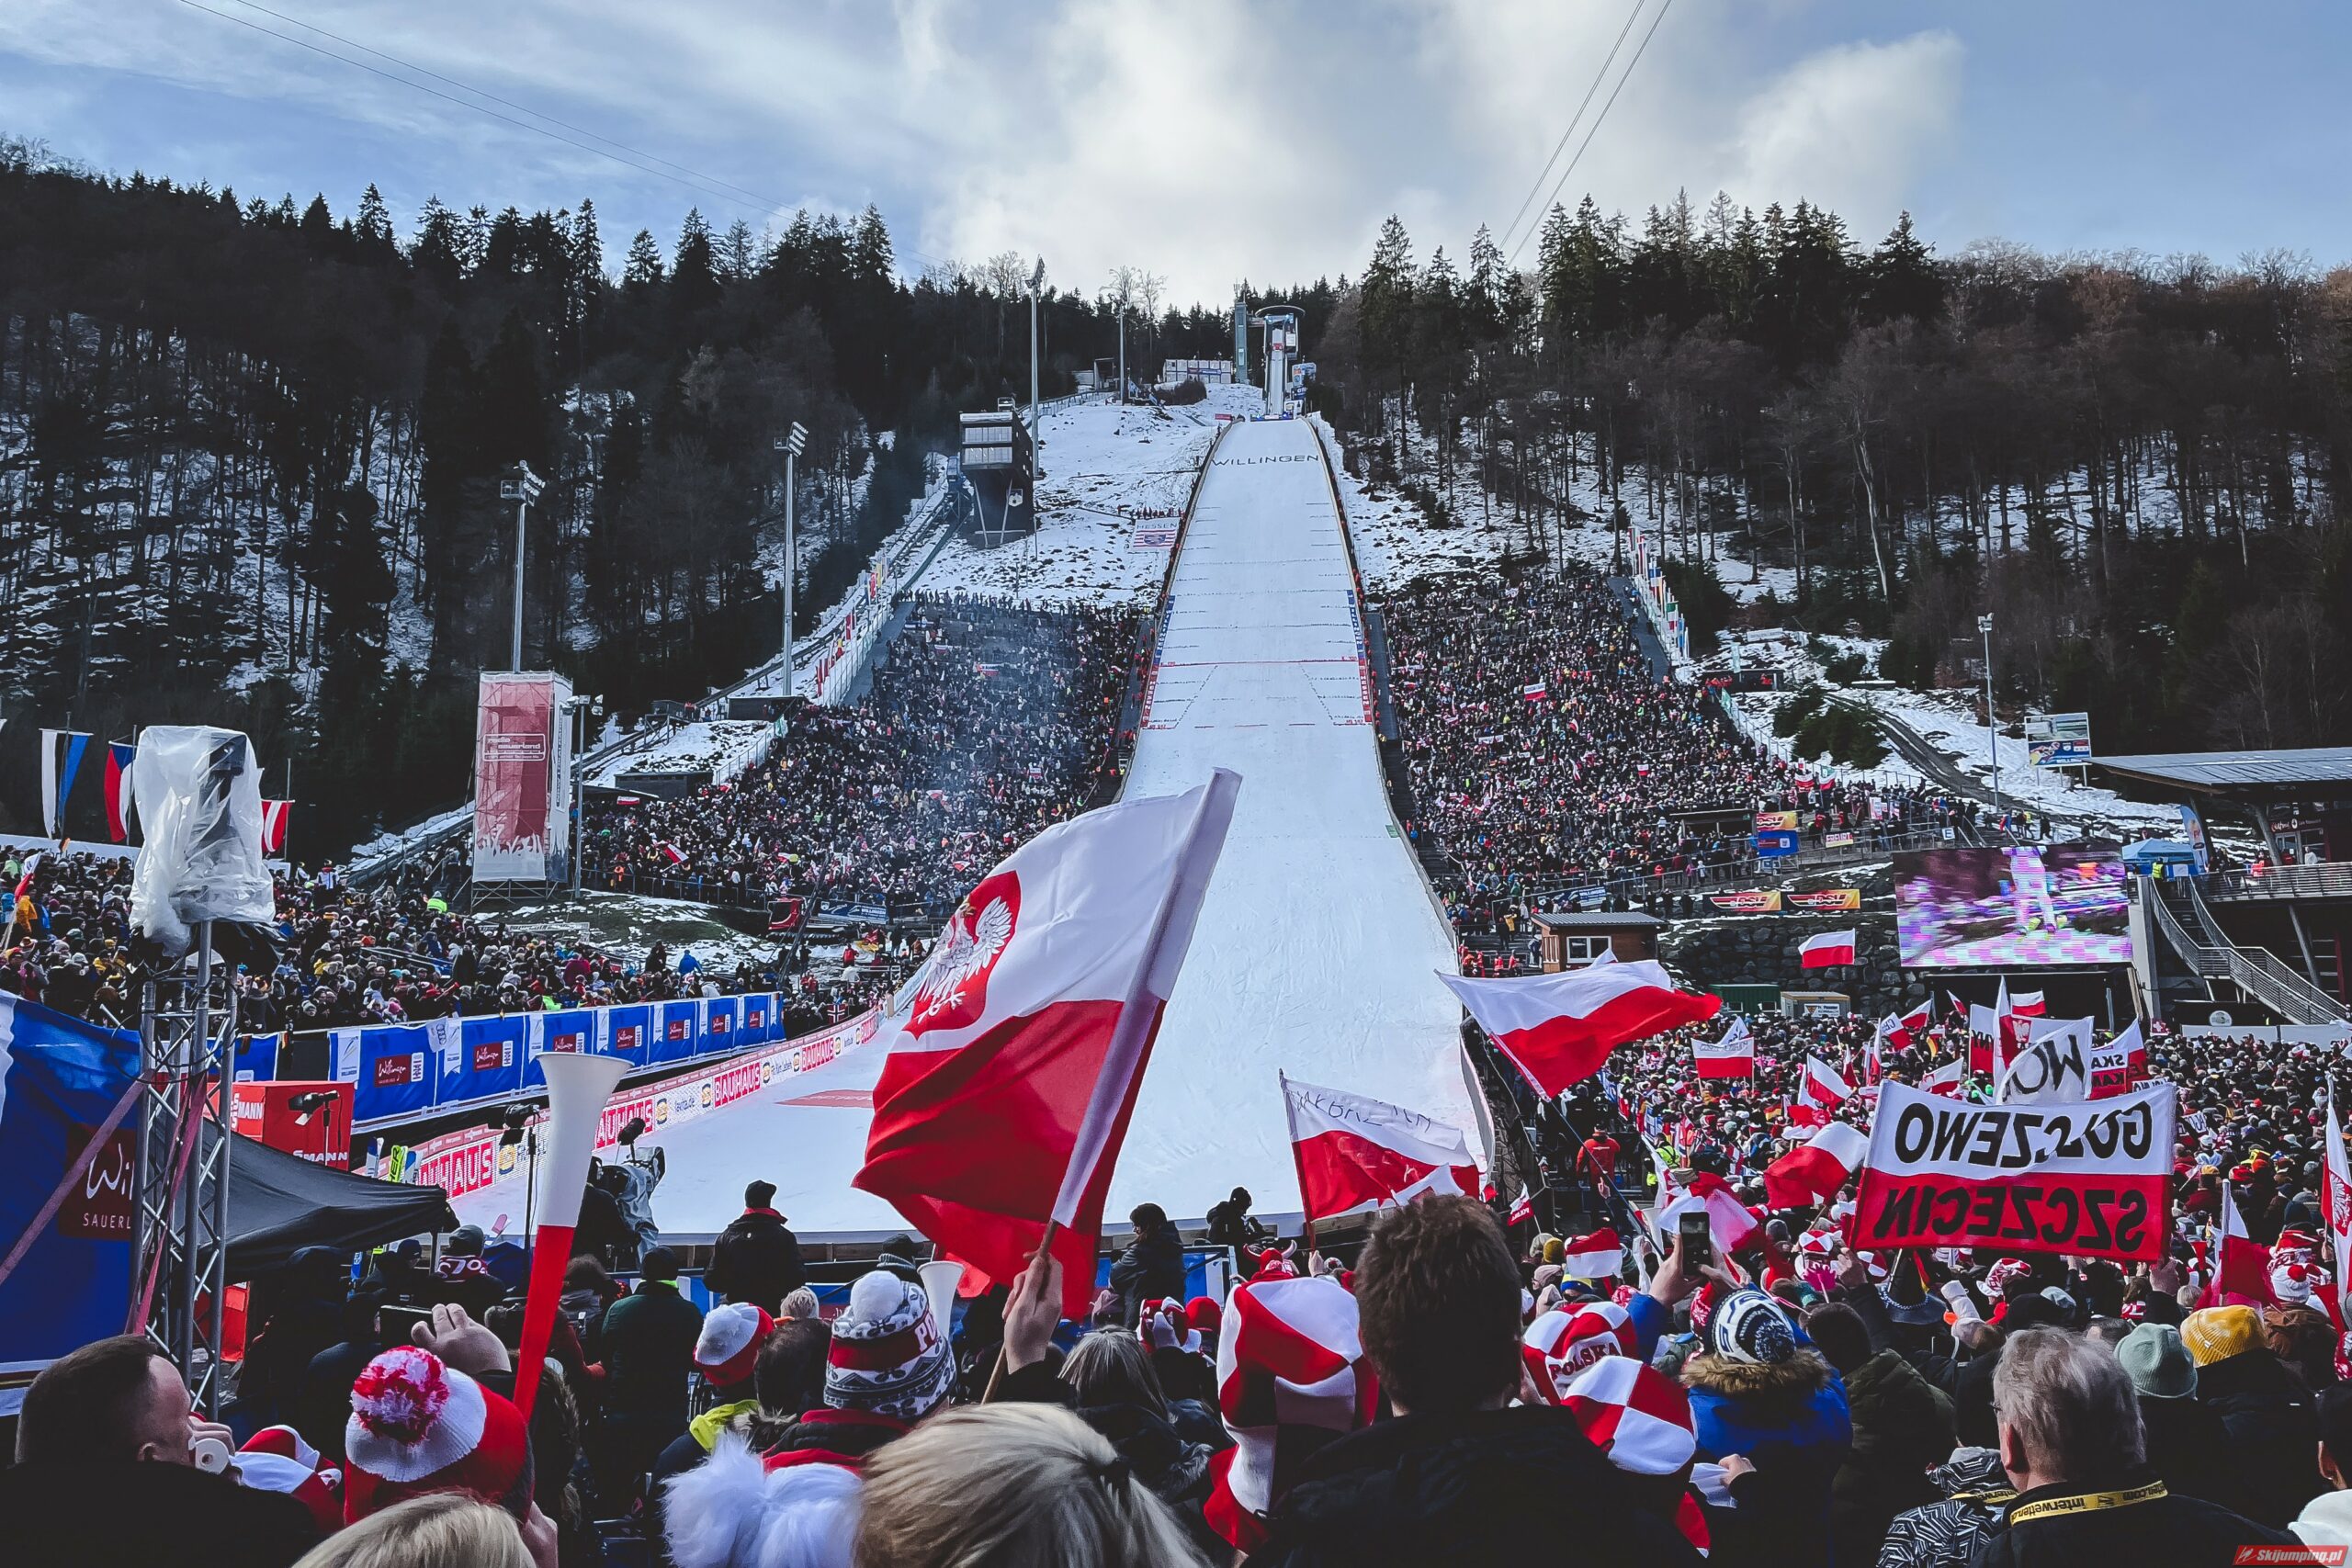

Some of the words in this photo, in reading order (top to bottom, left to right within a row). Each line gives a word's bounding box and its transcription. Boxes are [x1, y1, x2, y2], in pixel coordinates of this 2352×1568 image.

[1211, 455, 1318, 466] WILLINGEN
[802, 1038, 834, 1071] BAUHAUS
[714, 1063, 761, 1107] BAUHAUS
[1548, 1342, 1620, 1382] POLSKA
